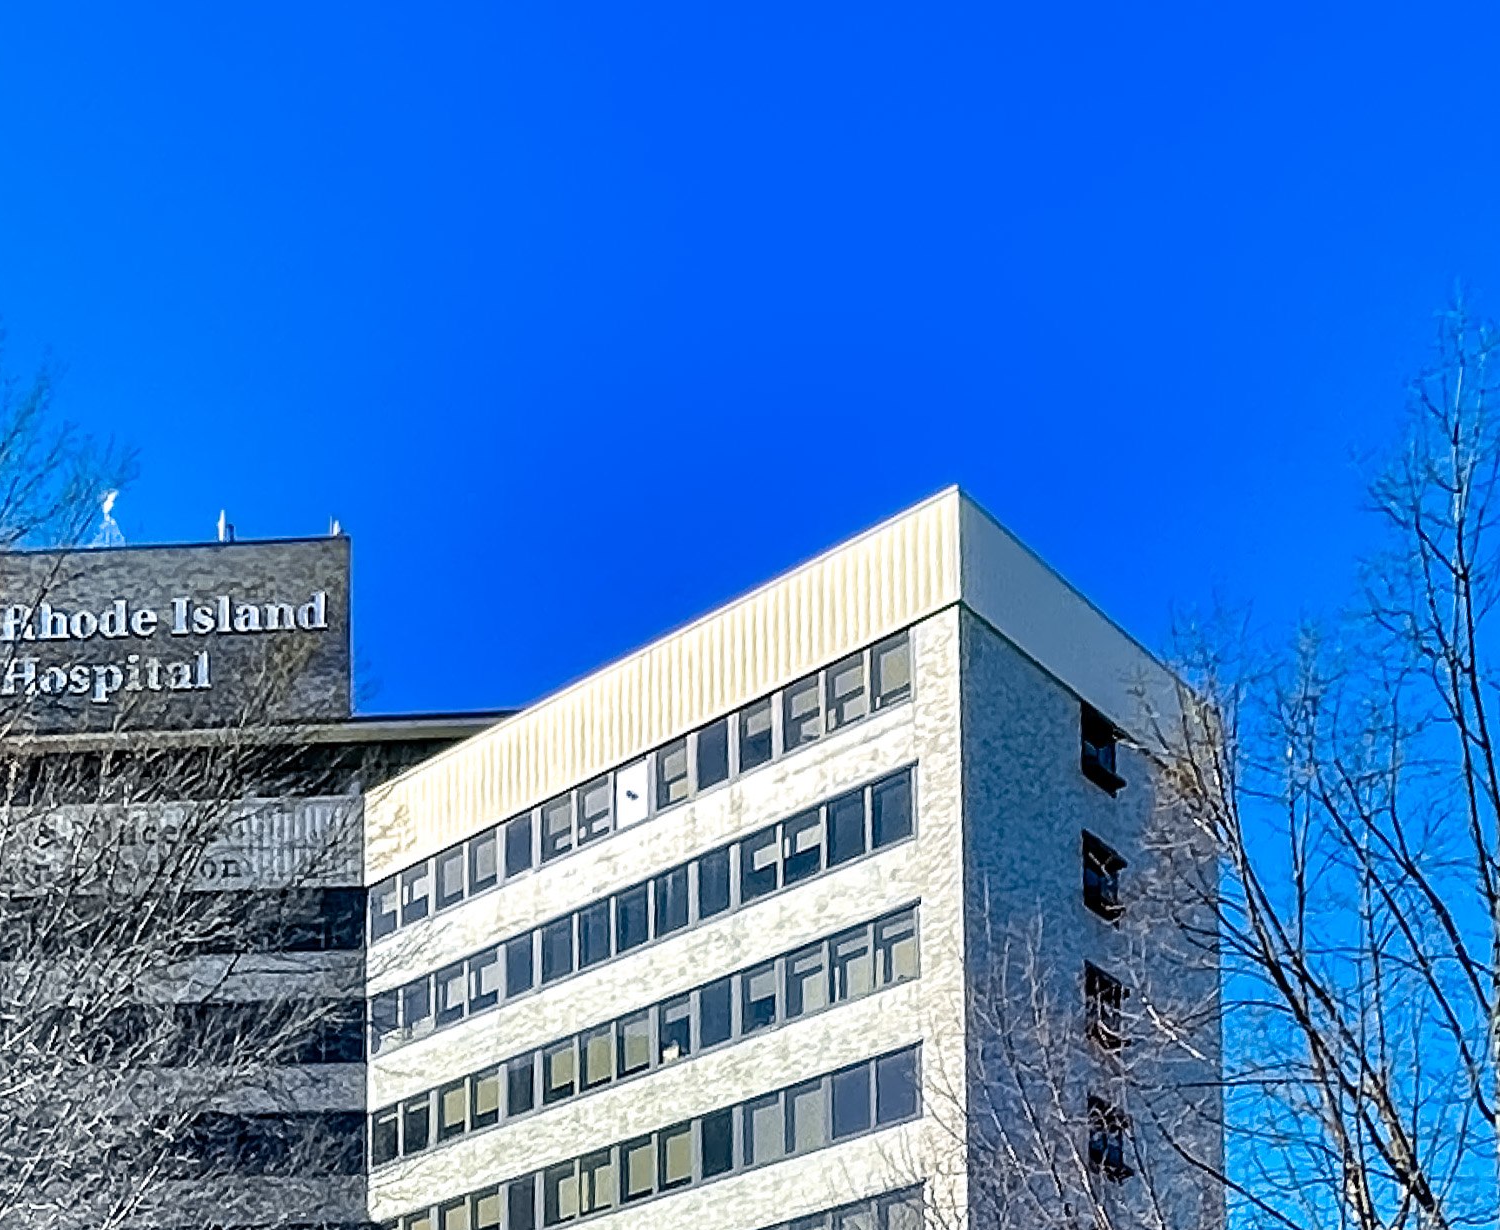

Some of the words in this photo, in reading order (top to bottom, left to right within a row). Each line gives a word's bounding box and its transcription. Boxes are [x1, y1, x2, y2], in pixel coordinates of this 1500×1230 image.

[0, 599, 158, 641] Rhode
[171, 591, 329, 635] Island
[0, 650, 212, 703] Hospital
